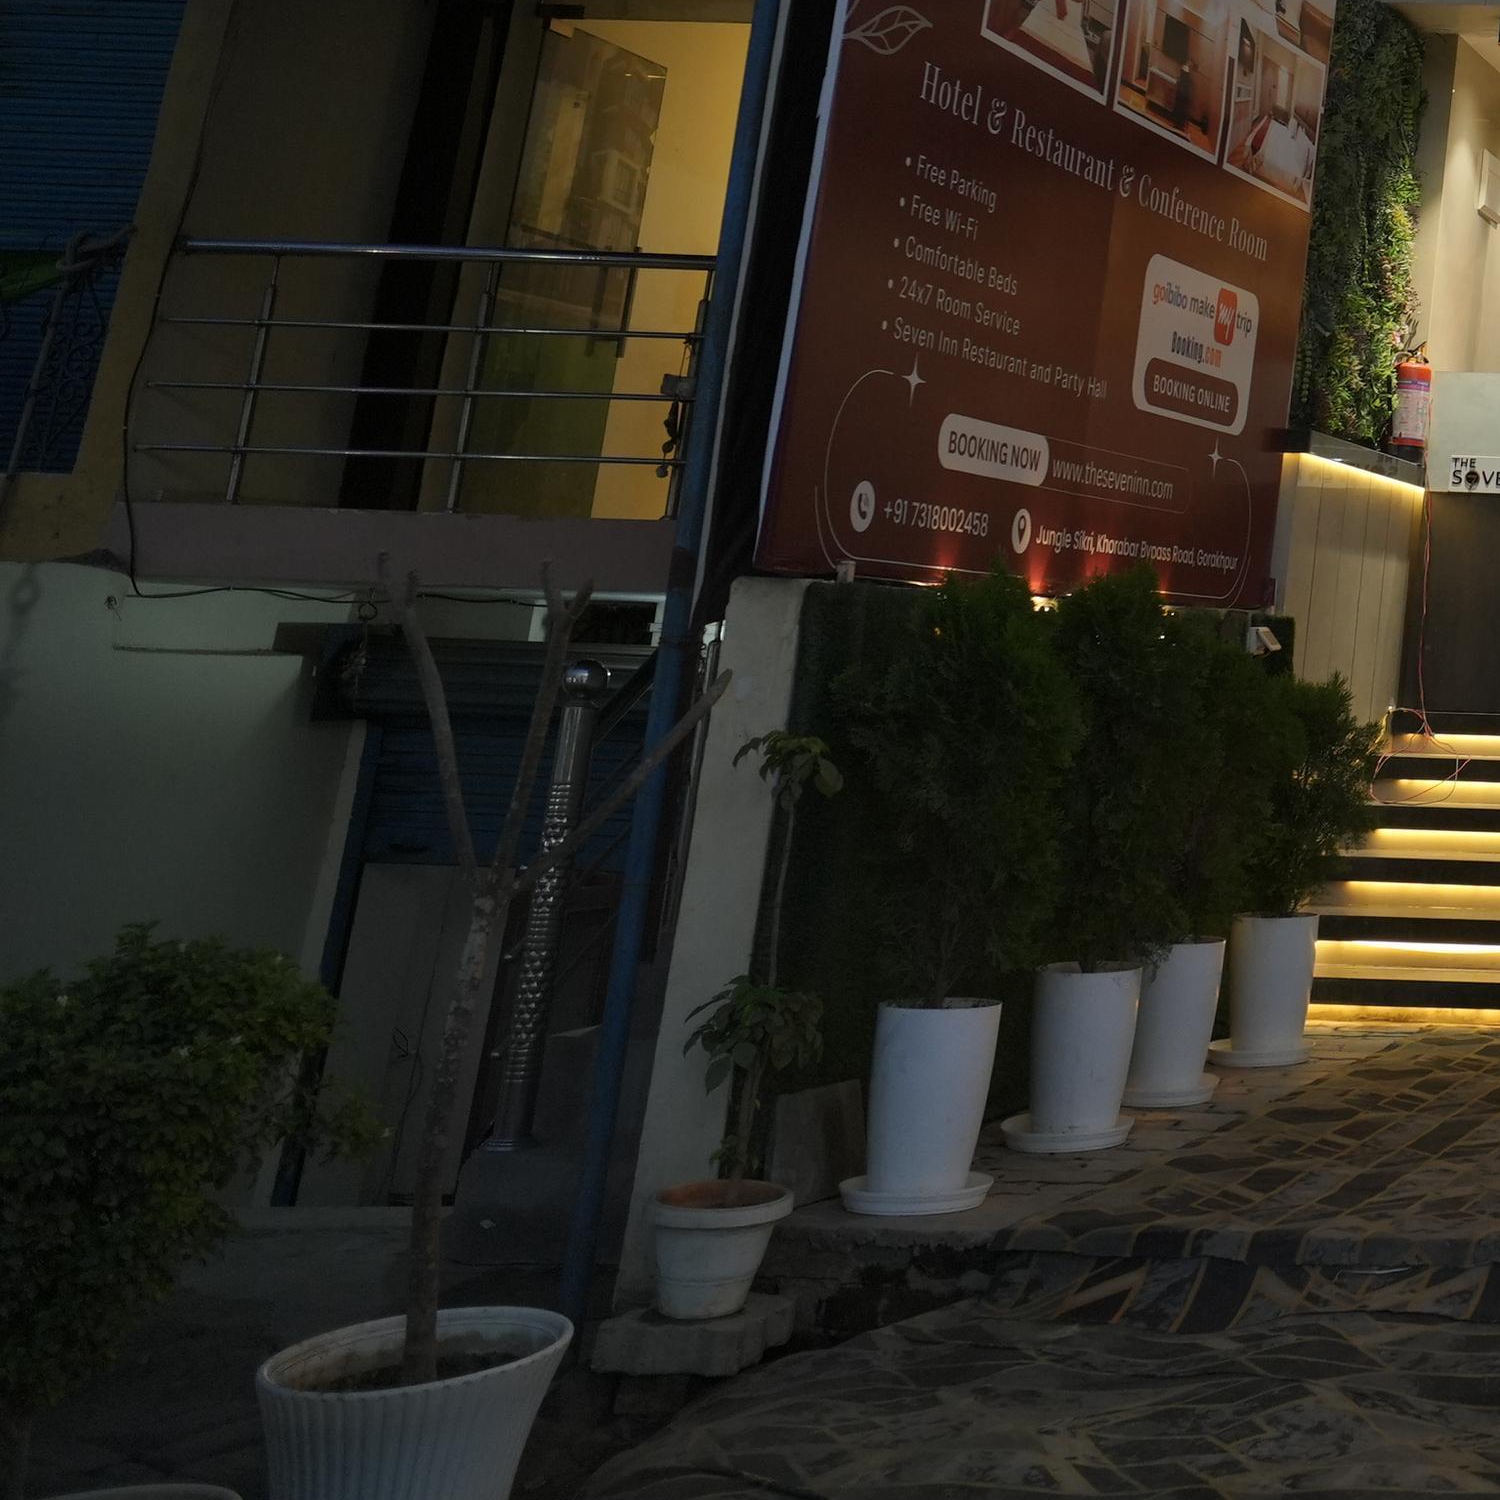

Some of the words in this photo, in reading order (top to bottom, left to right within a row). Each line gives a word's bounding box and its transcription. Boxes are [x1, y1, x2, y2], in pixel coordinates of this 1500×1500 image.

[916, 154, 947, 187] Free
[949, 169, 998, 214] Parking
[919, 61, 983, 126] Hotel
[987, 97, 1008, 135] &
[1010, 108, 1116, 191] Restaurant
[1119, 164, 1135, 198] &
[1138, 173, 1225, 242] Conference
[1227, 216, 1269, 262] Room
[910, 194, 941, 227] Free
[945, 207, 979, 241] Wi-Fi
[904, 235, 985, 284] Comfortable
[988, 266, 1018, 296] Beds
[898, 275, 934, 306] 24x7
[935, 288, 972, 320] Room
[974, 302, 1021, 336] Service
[1152, 281, 1188, 309] goibibo
[1189, 296, 1216, 320] make
[1236, 311, 1253, 338] trip
[893, 316, 935, 350] Seven
[938, 330, 958, 357] Inn
[961, 337, 1028, 376] Restaurant
[1029, 362, 1052, 383] and
[1053, 366, 1085, 397] Party
[1087, 376, 1108, 400] Hall
[1171, 330, 1223, 368] Booking.com
[1152, 374, 1196, 404] BOOKING
[1197, 387, 1231, 413] ONLINE
[947, 430, 1010, 466] BOOKING
[1010, 447, 1042, 472] NOW
[1051, 457, 1174, 501] www.theseveninn.com
[1452, 457, 1477, 469] THE
[883, 498, 908, 525] +91
[910, 500, 990, 537] 7318002458
[1036, 525, 1072, 553] Jungle
